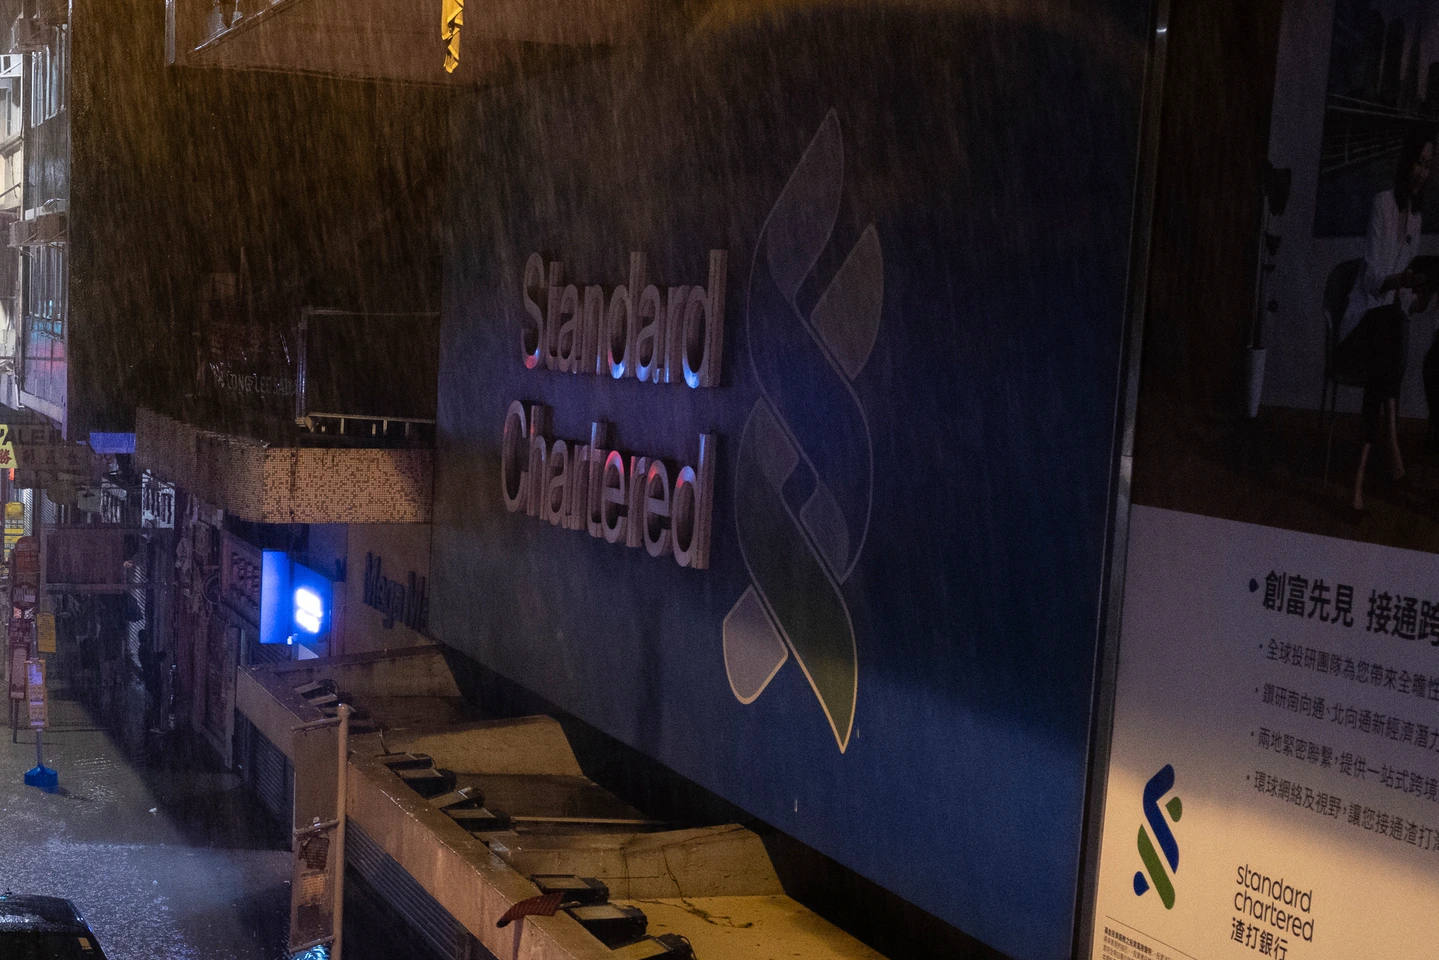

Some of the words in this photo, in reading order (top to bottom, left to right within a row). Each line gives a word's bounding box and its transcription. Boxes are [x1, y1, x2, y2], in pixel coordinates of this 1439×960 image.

[520, 249, 728, 389] Standard
[501, 399, 717, 570] Chartered
[1262, 568, 1355, 628] 創富先見
[1366, 588, 1439, 647] 接通跨
[1233, 894, 1315, 944] chartered
[1236, 863, 1314, 916] standard
